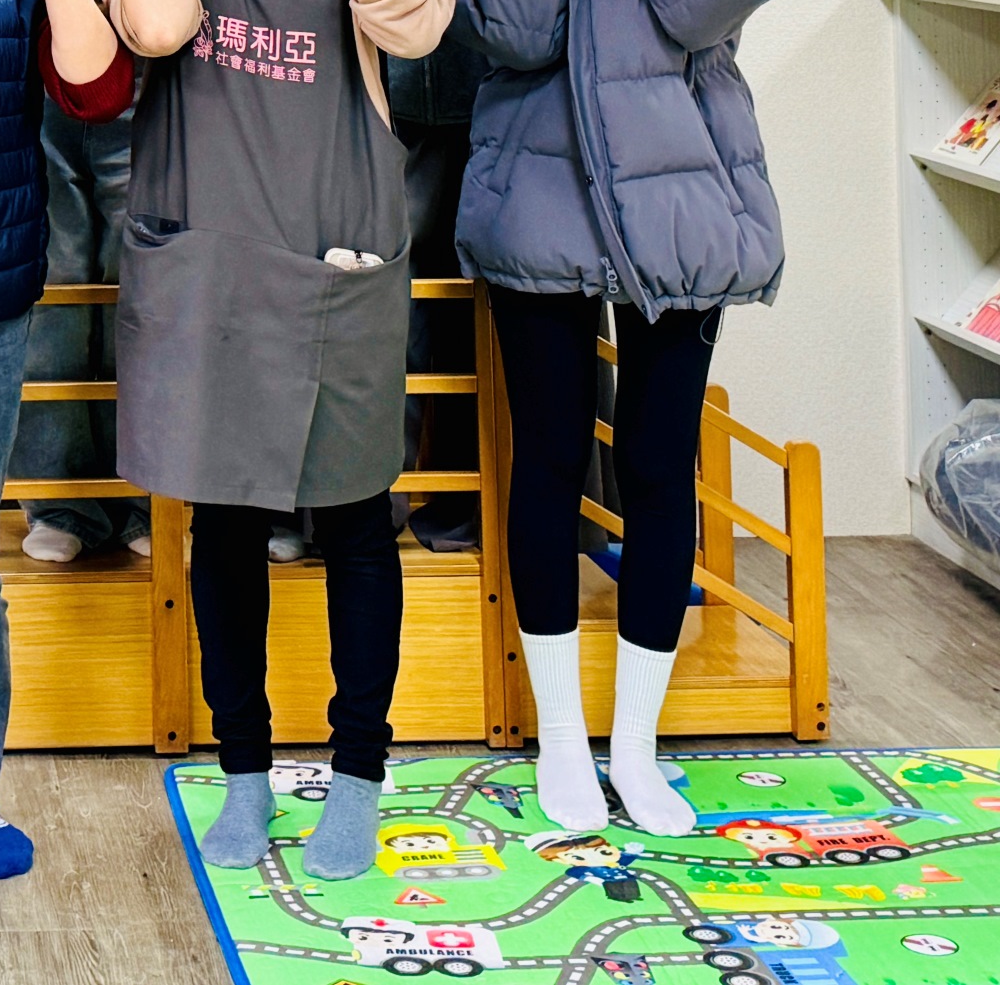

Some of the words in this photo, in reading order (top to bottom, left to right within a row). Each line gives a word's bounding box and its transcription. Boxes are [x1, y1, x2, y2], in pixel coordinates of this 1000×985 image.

[215, 15, 317, 64] 瑪利亞
[215, 51, 317, 84] 社會福利基金會
[816, 838, 849, 847] FIRE
[852, 834, 891, 845] DEPT.
[401, 853, 446, 862] CRANE
[385, 948, 475, 956] AMBULANCE
[769, 962, 799, 984] TRUCK
